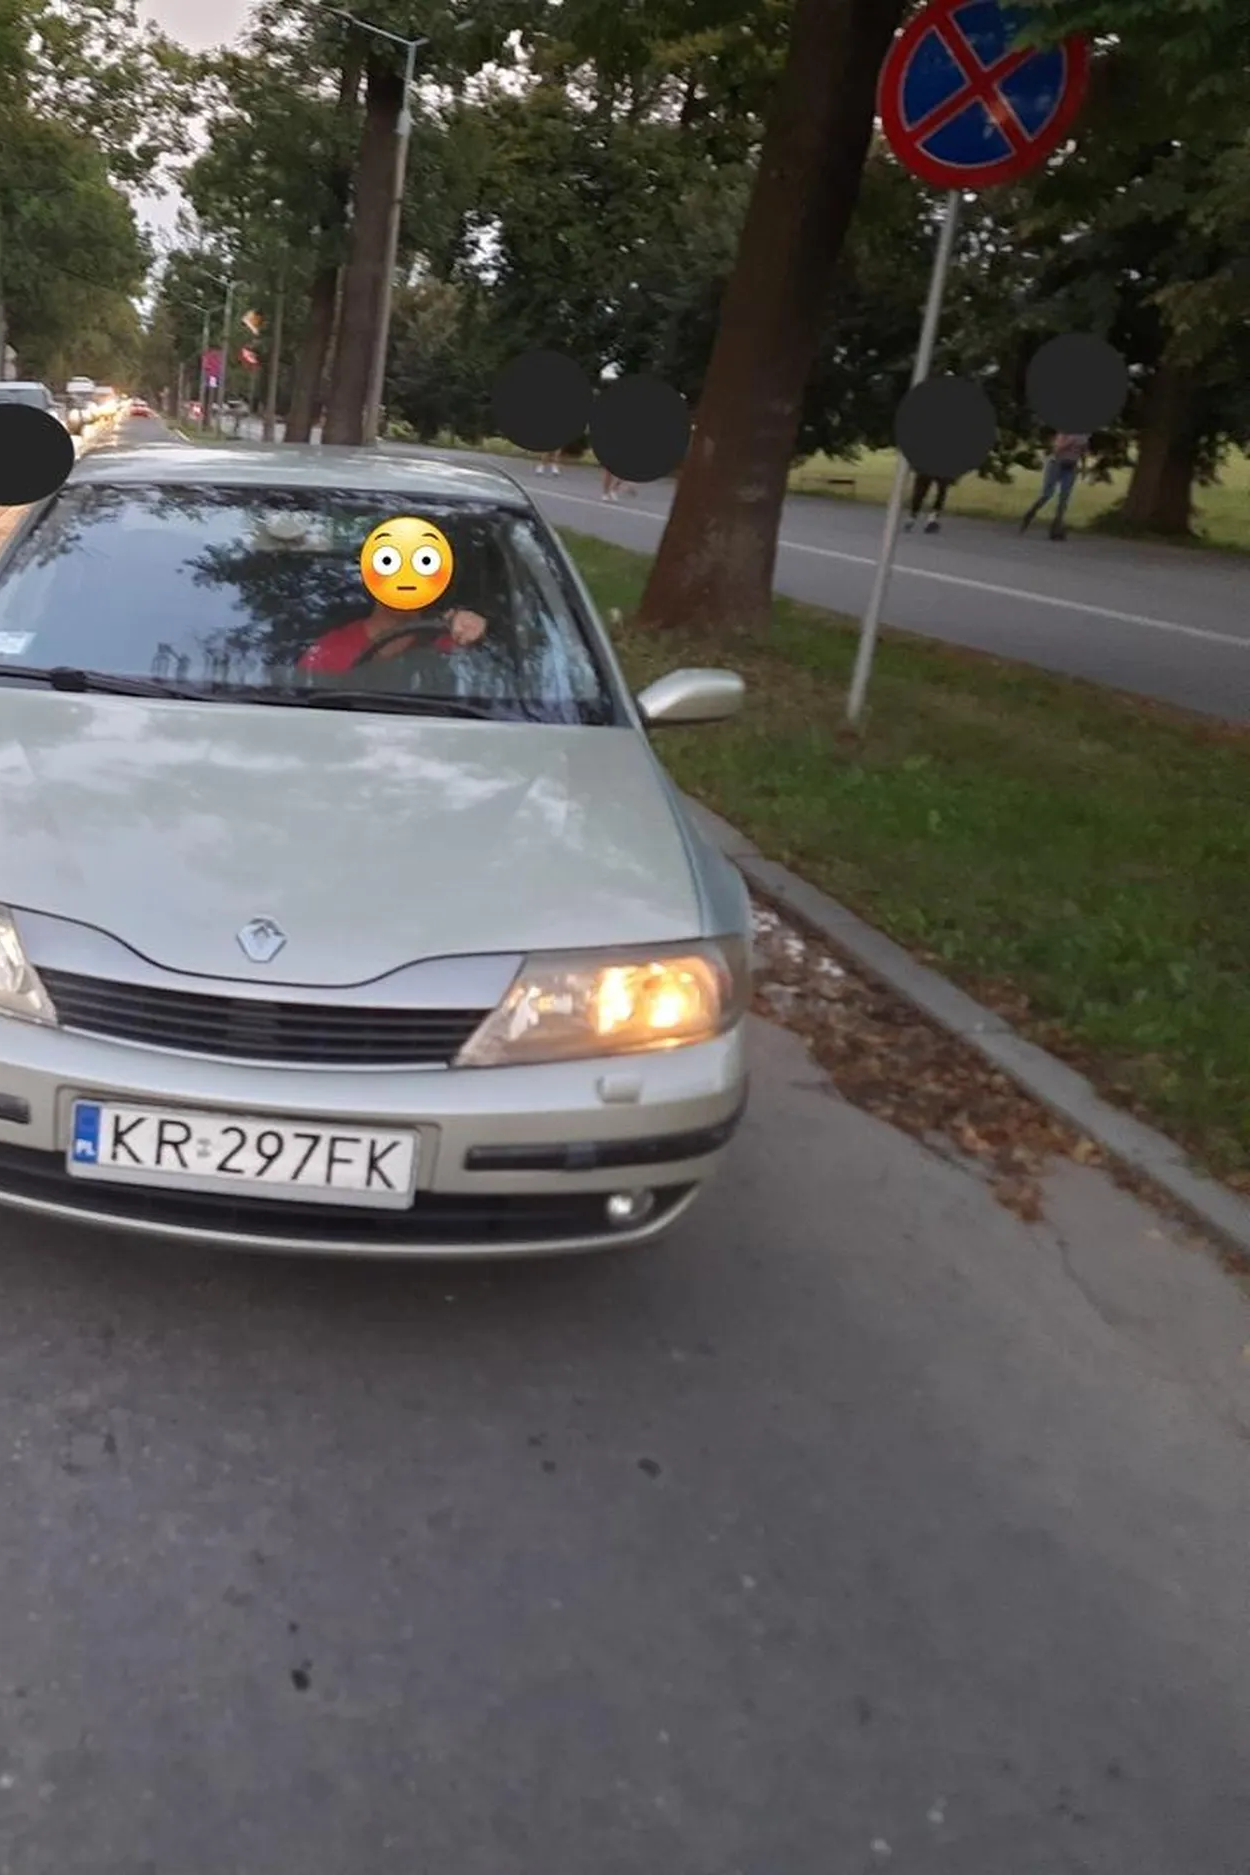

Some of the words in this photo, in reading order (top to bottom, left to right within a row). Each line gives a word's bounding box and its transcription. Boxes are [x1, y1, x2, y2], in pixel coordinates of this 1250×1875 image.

[76, 1139, 96, 1157] PL
[111, 1114, 192, 1168] KR
[216, 1126, 401, 1190] 297FK
